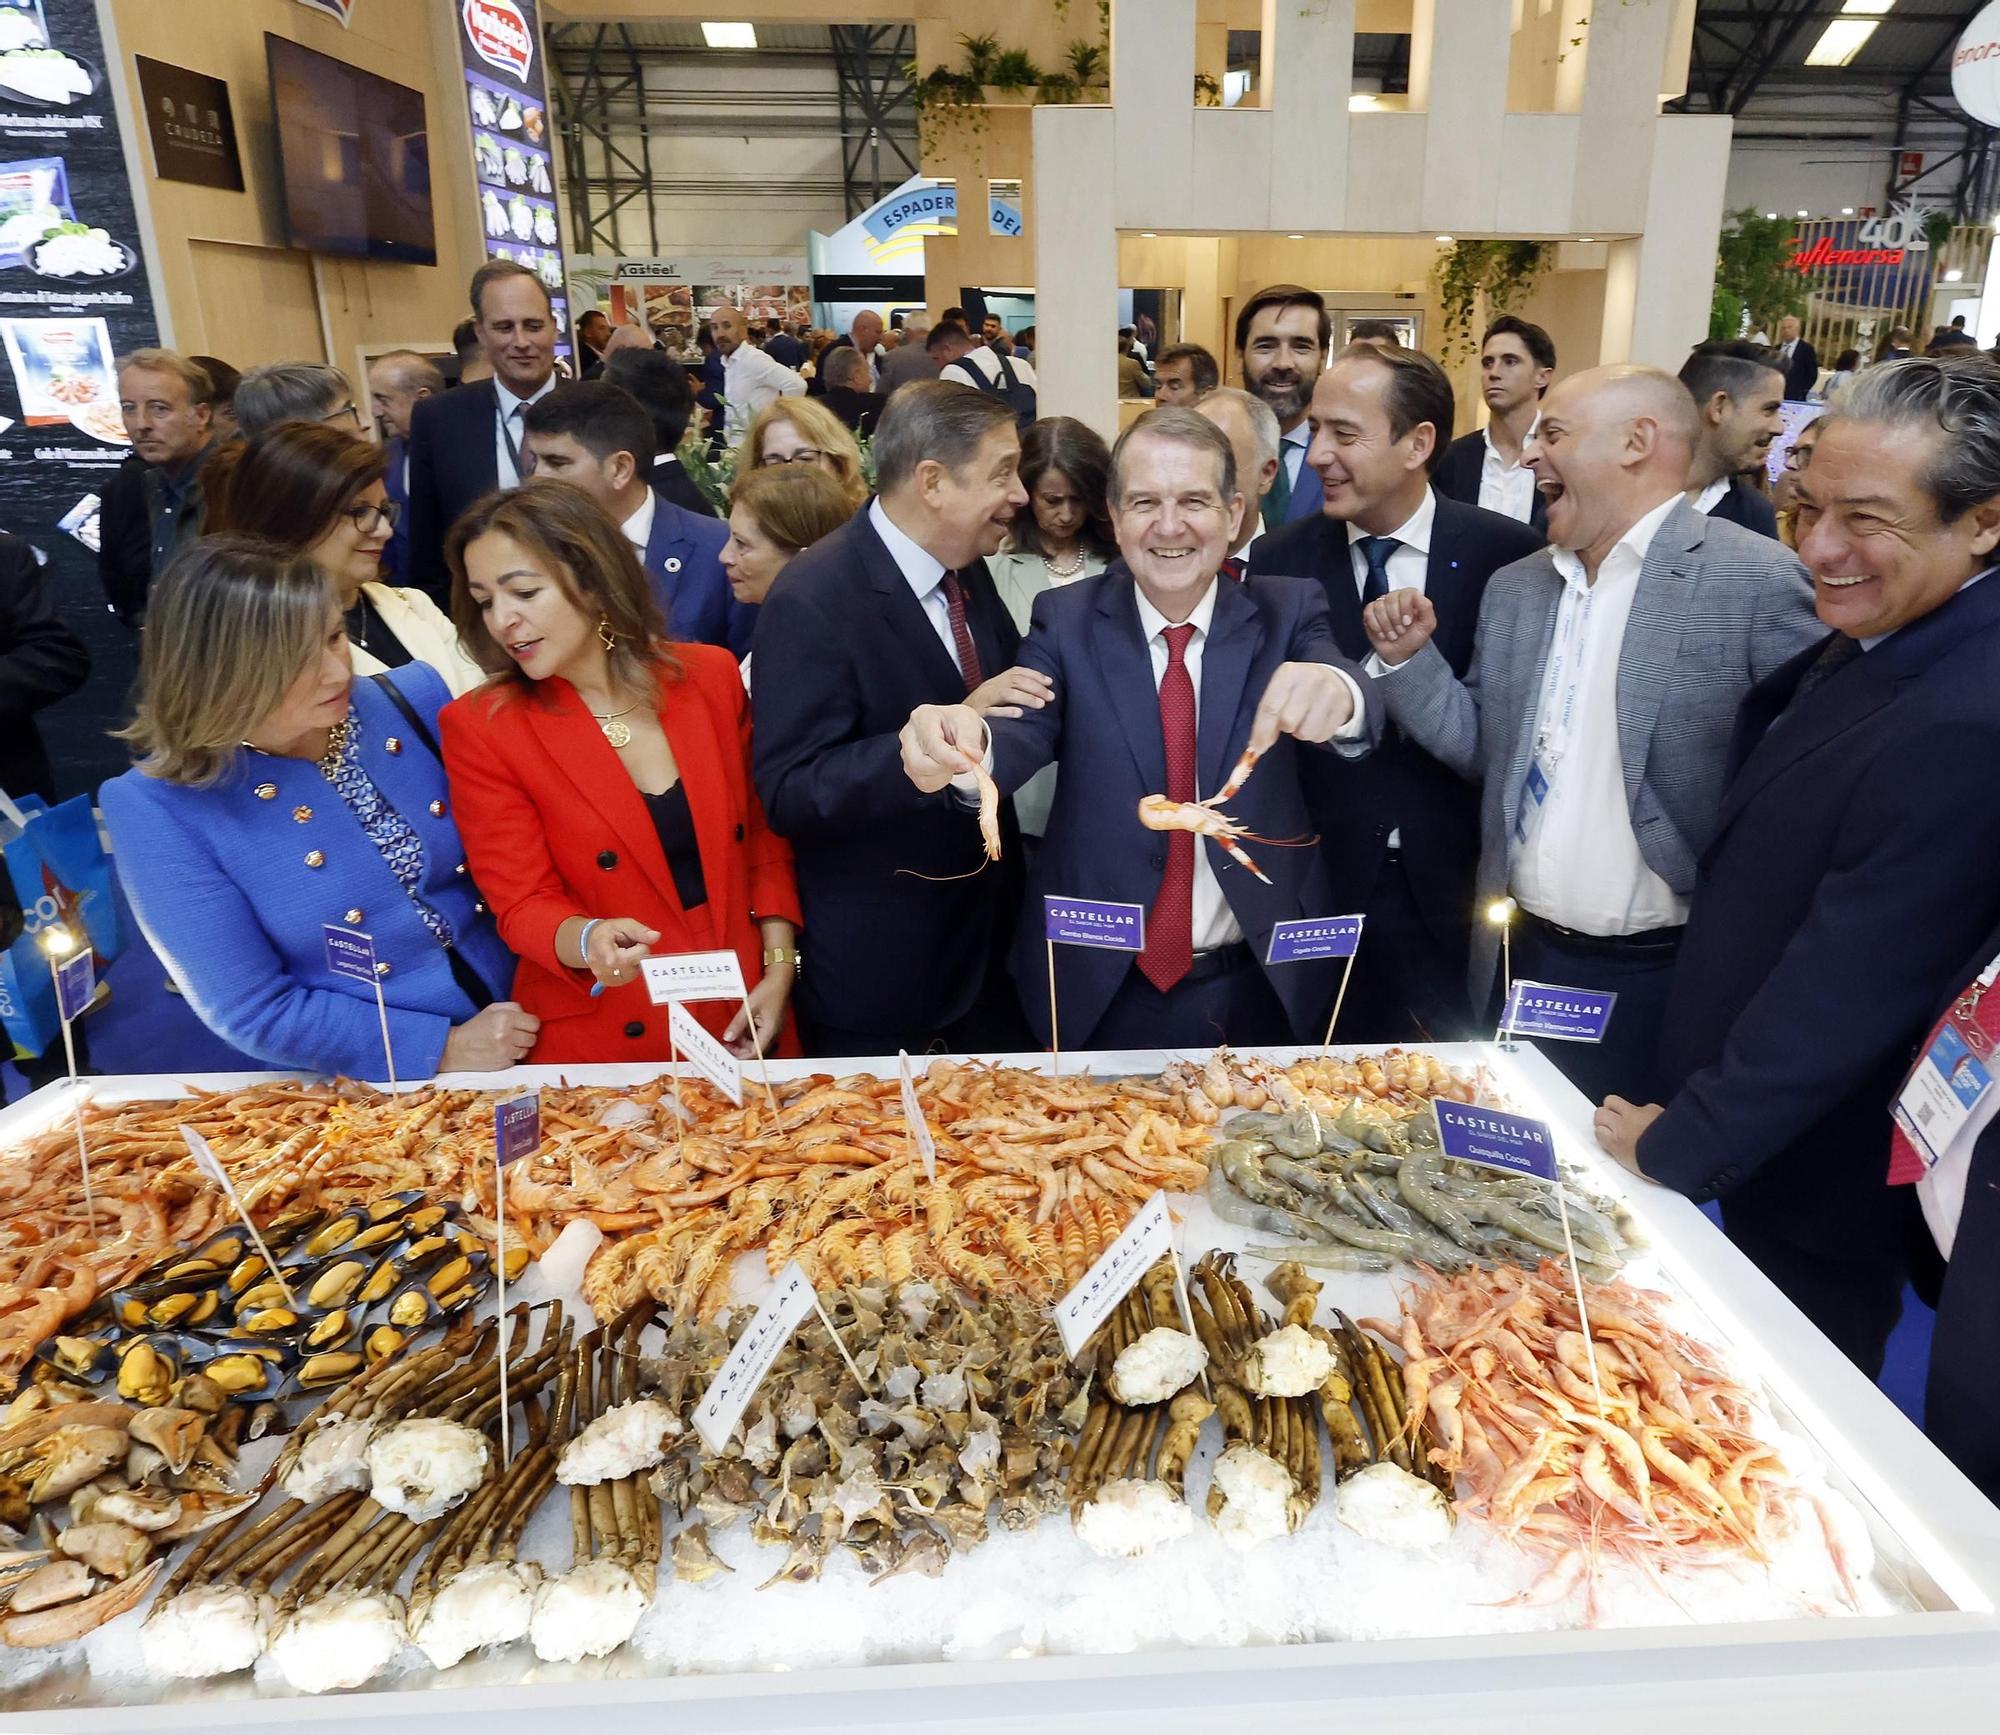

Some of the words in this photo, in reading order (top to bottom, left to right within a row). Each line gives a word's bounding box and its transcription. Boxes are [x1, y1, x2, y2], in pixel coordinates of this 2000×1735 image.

[1050, 908, 1134, 925] CASTELLAR
[1279, 927, 1356, 940] CASTELLAR
[652, 965, 732, 977] CASTELLAR
[1445, 1113, 1543, 1144] CASTELLAR
[1468, 1144, 1504, 1160] Quisquilla
[1071, 1213, 1162, 1318] CASTELLAR
[709, 1280, 798, 1417] CASTELLAR
